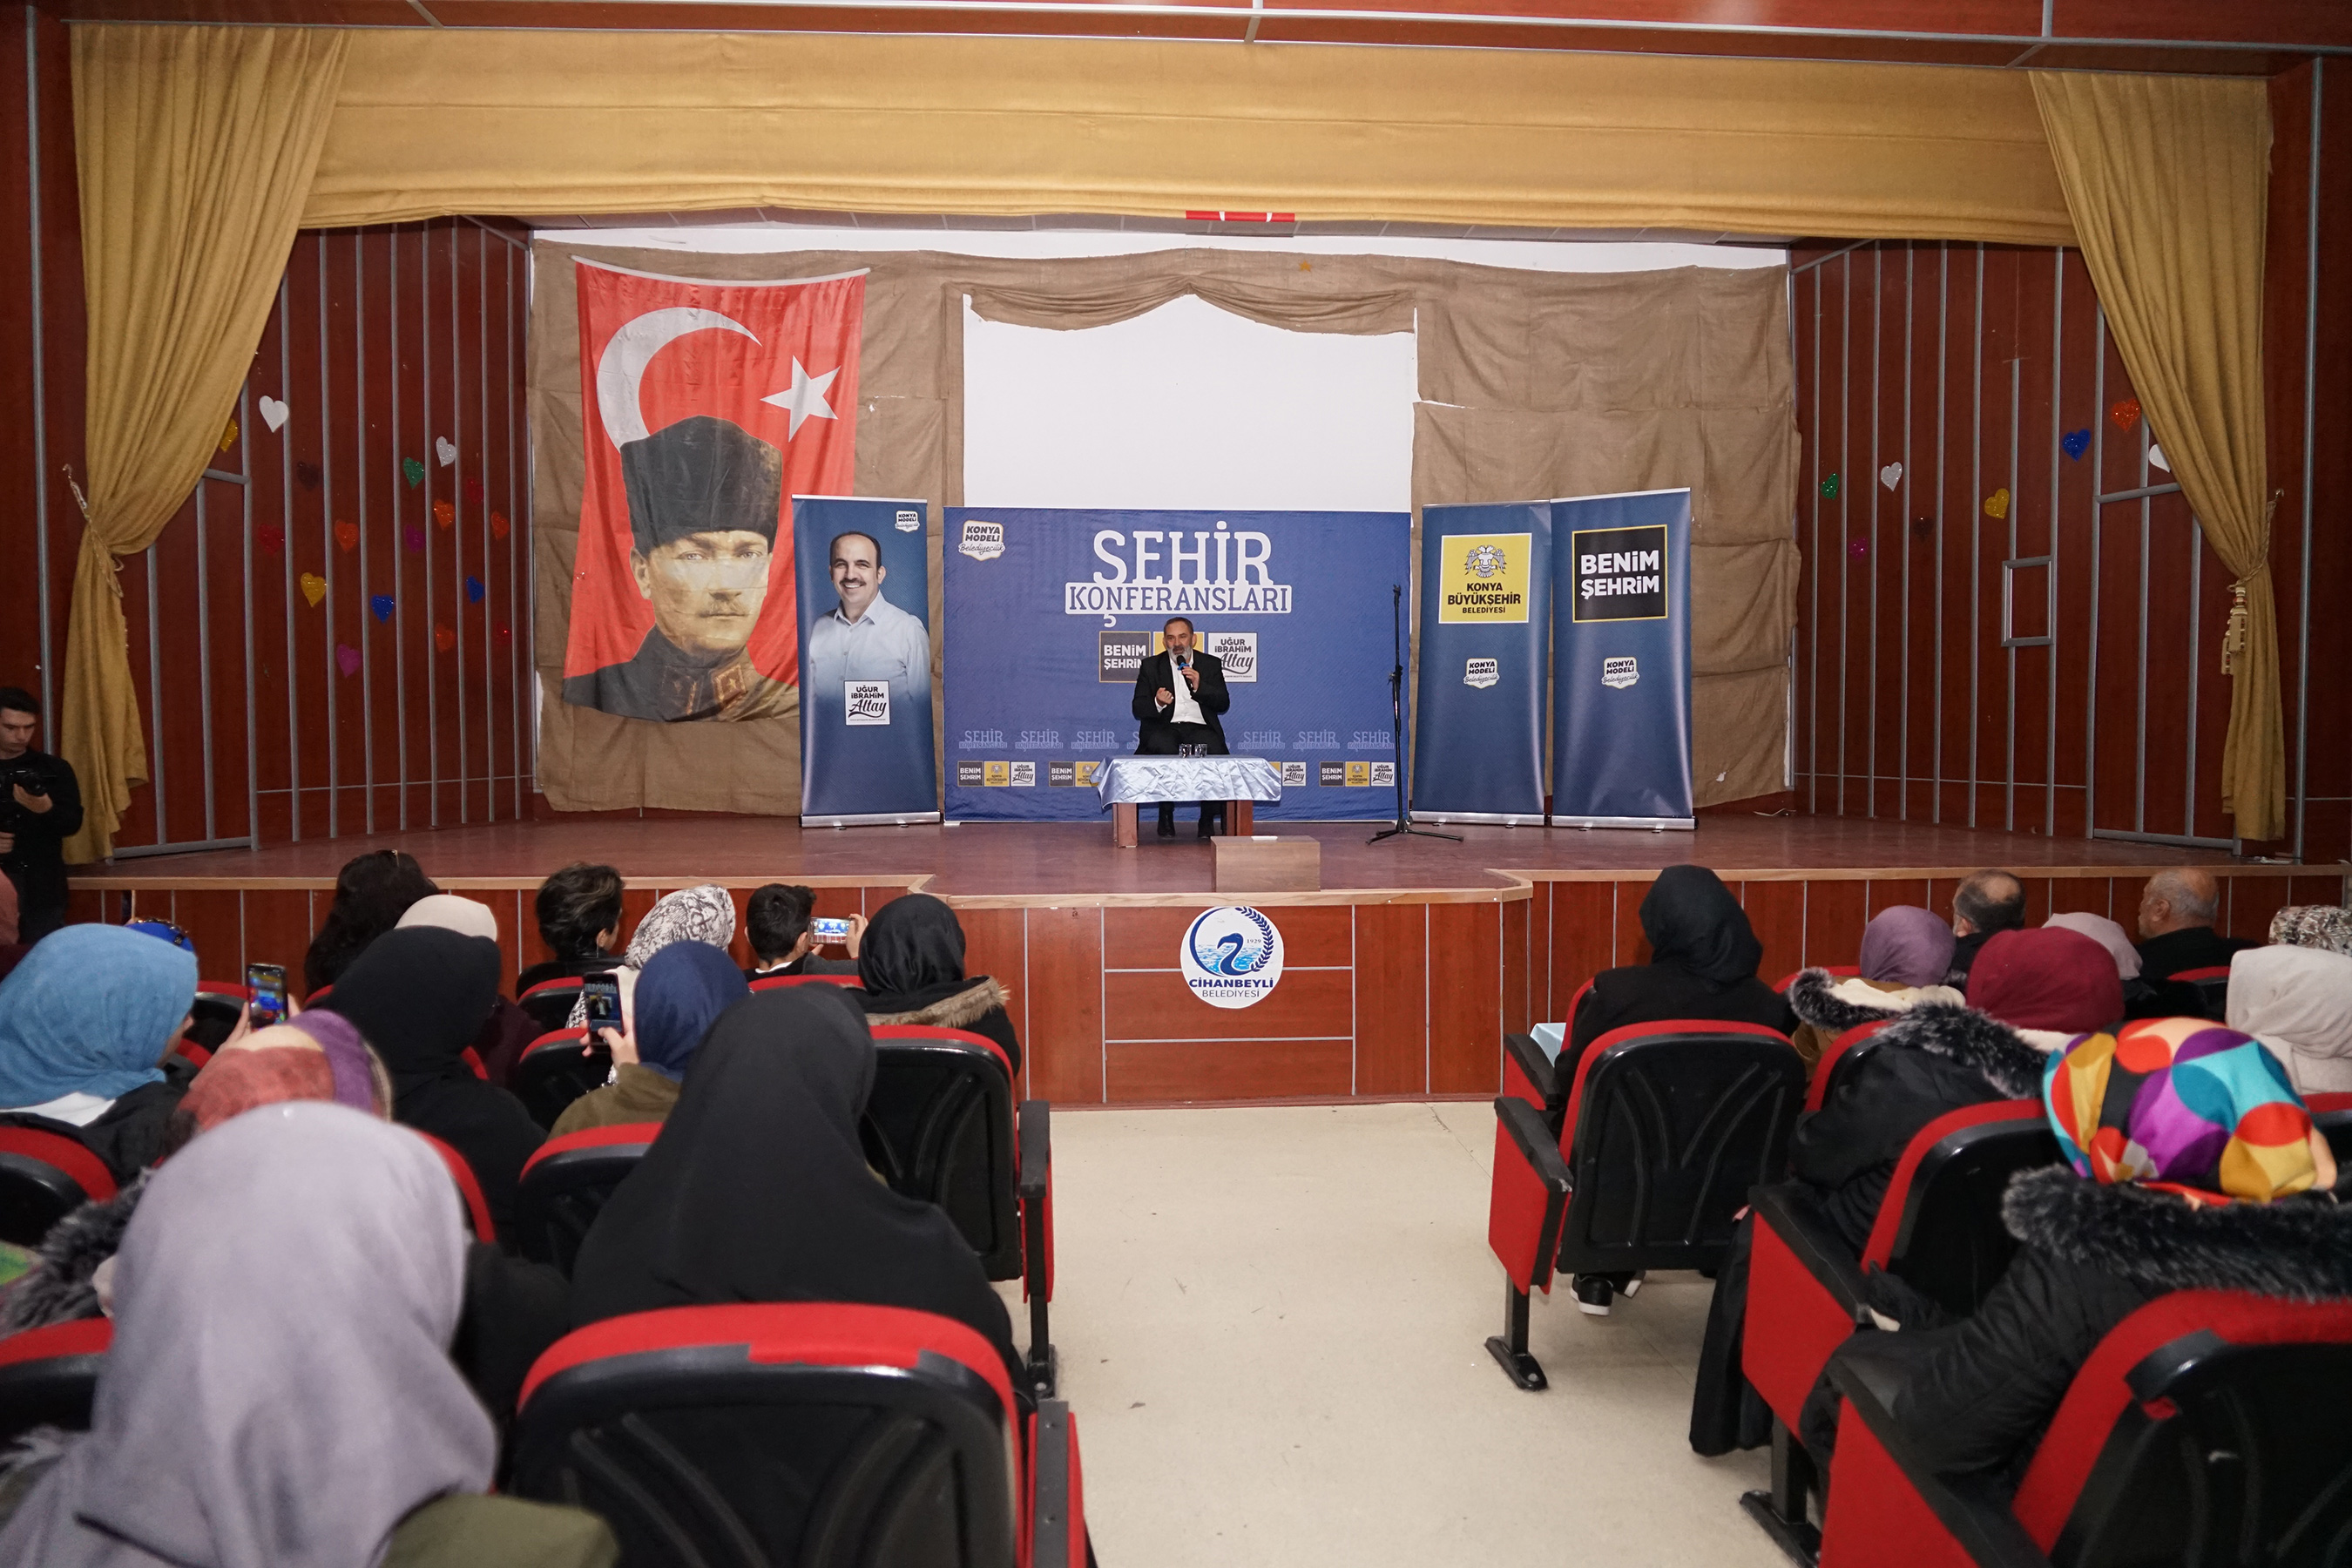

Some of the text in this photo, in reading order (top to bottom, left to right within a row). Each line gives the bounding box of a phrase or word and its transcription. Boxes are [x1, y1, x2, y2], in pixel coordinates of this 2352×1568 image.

[967, 525, 1000, 534] KONYA
[1581, 550, 1659, 575] BENİM
[1093, 520, 1274, 627] ŞEHİR
[1467, 582, 1503, 591] KONYA
[1581, 575, 1659, 600] ŞEHRİM
[1069, 586, 1288, 612] KONFERANSLARI
[1447, 591, 1521, 606] BÜYÜKŞEHİR
[1220, 637, 1246, 645] UĞUR
[1104, 645, 1146, 656] BENİM
[1606, 659, 1634, 668] KONYA
[848, 699, 887, 718] Altay
[1189, 977, 1274, 988] CİHANBEYLİ
[1202, 989, 1260, 997] BELEDİYESİ
